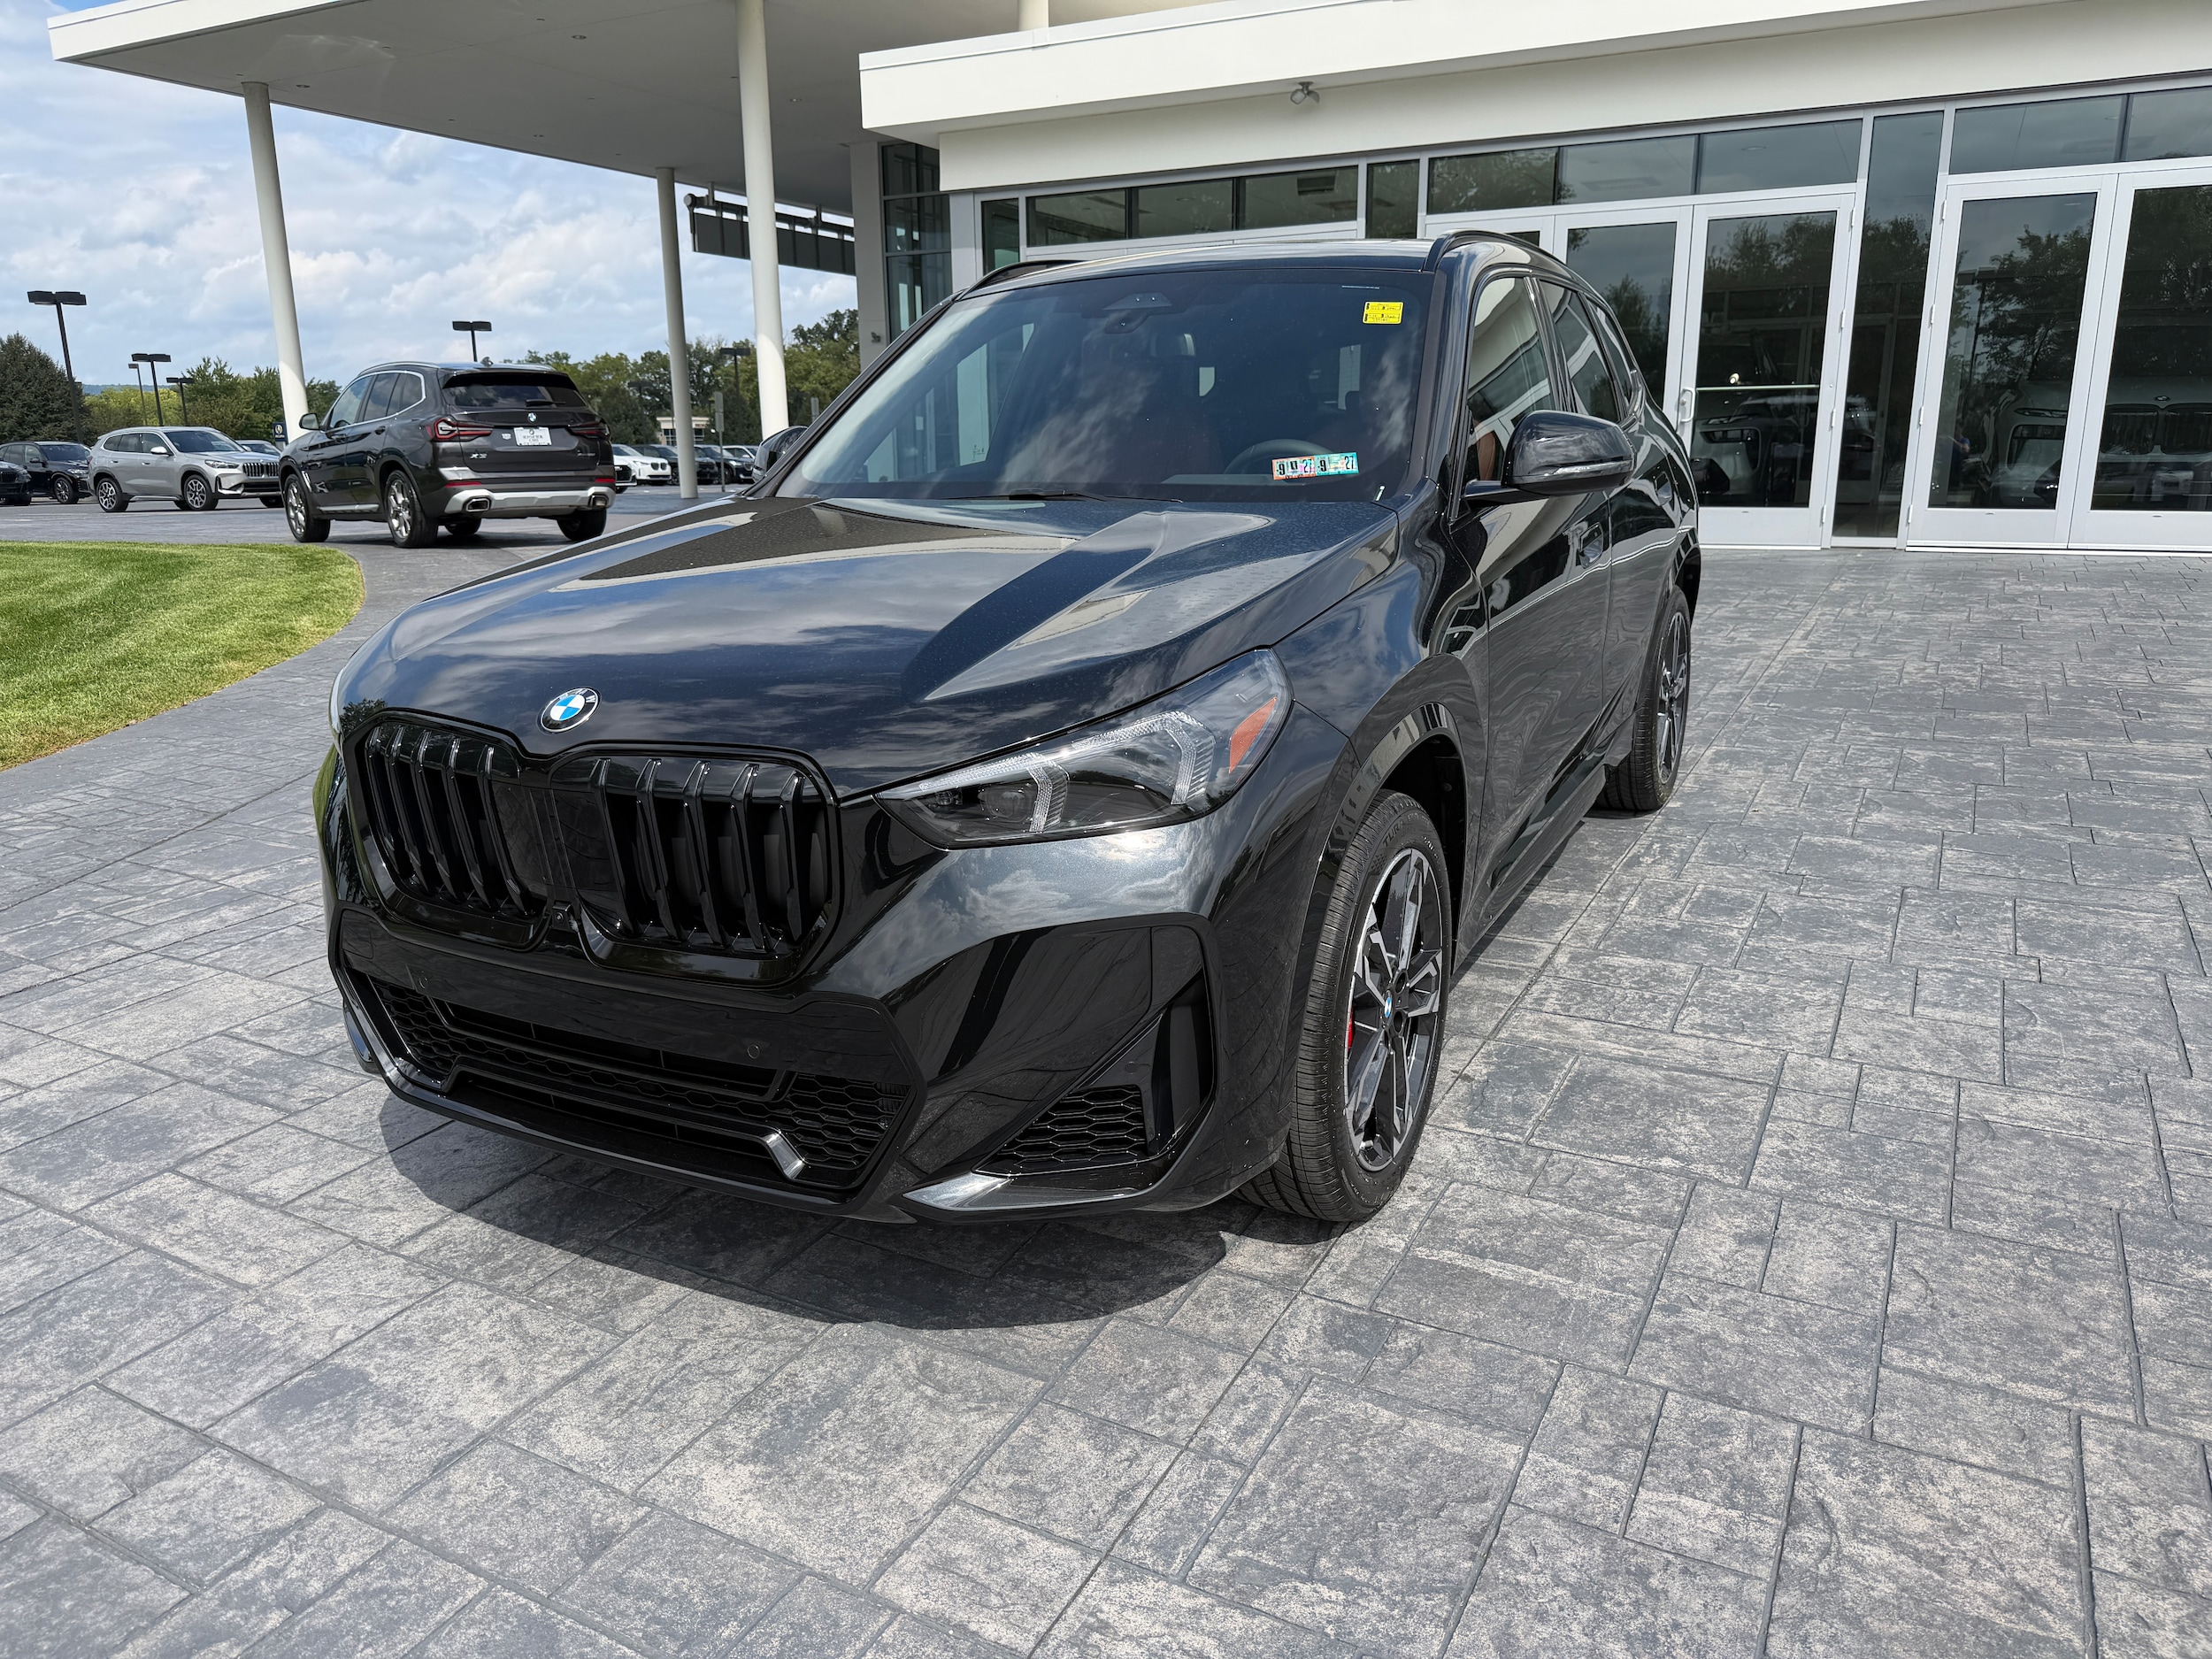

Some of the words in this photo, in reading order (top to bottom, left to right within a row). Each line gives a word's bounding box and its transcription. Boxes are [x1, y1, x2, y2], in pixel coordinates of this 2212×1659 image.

[1279, 463, 1286, 476] 9
[1302, 458, 1313, 473] 27
[1319, 459, 1327, 472] 9
[1344, 455, 1355, 470] 27
